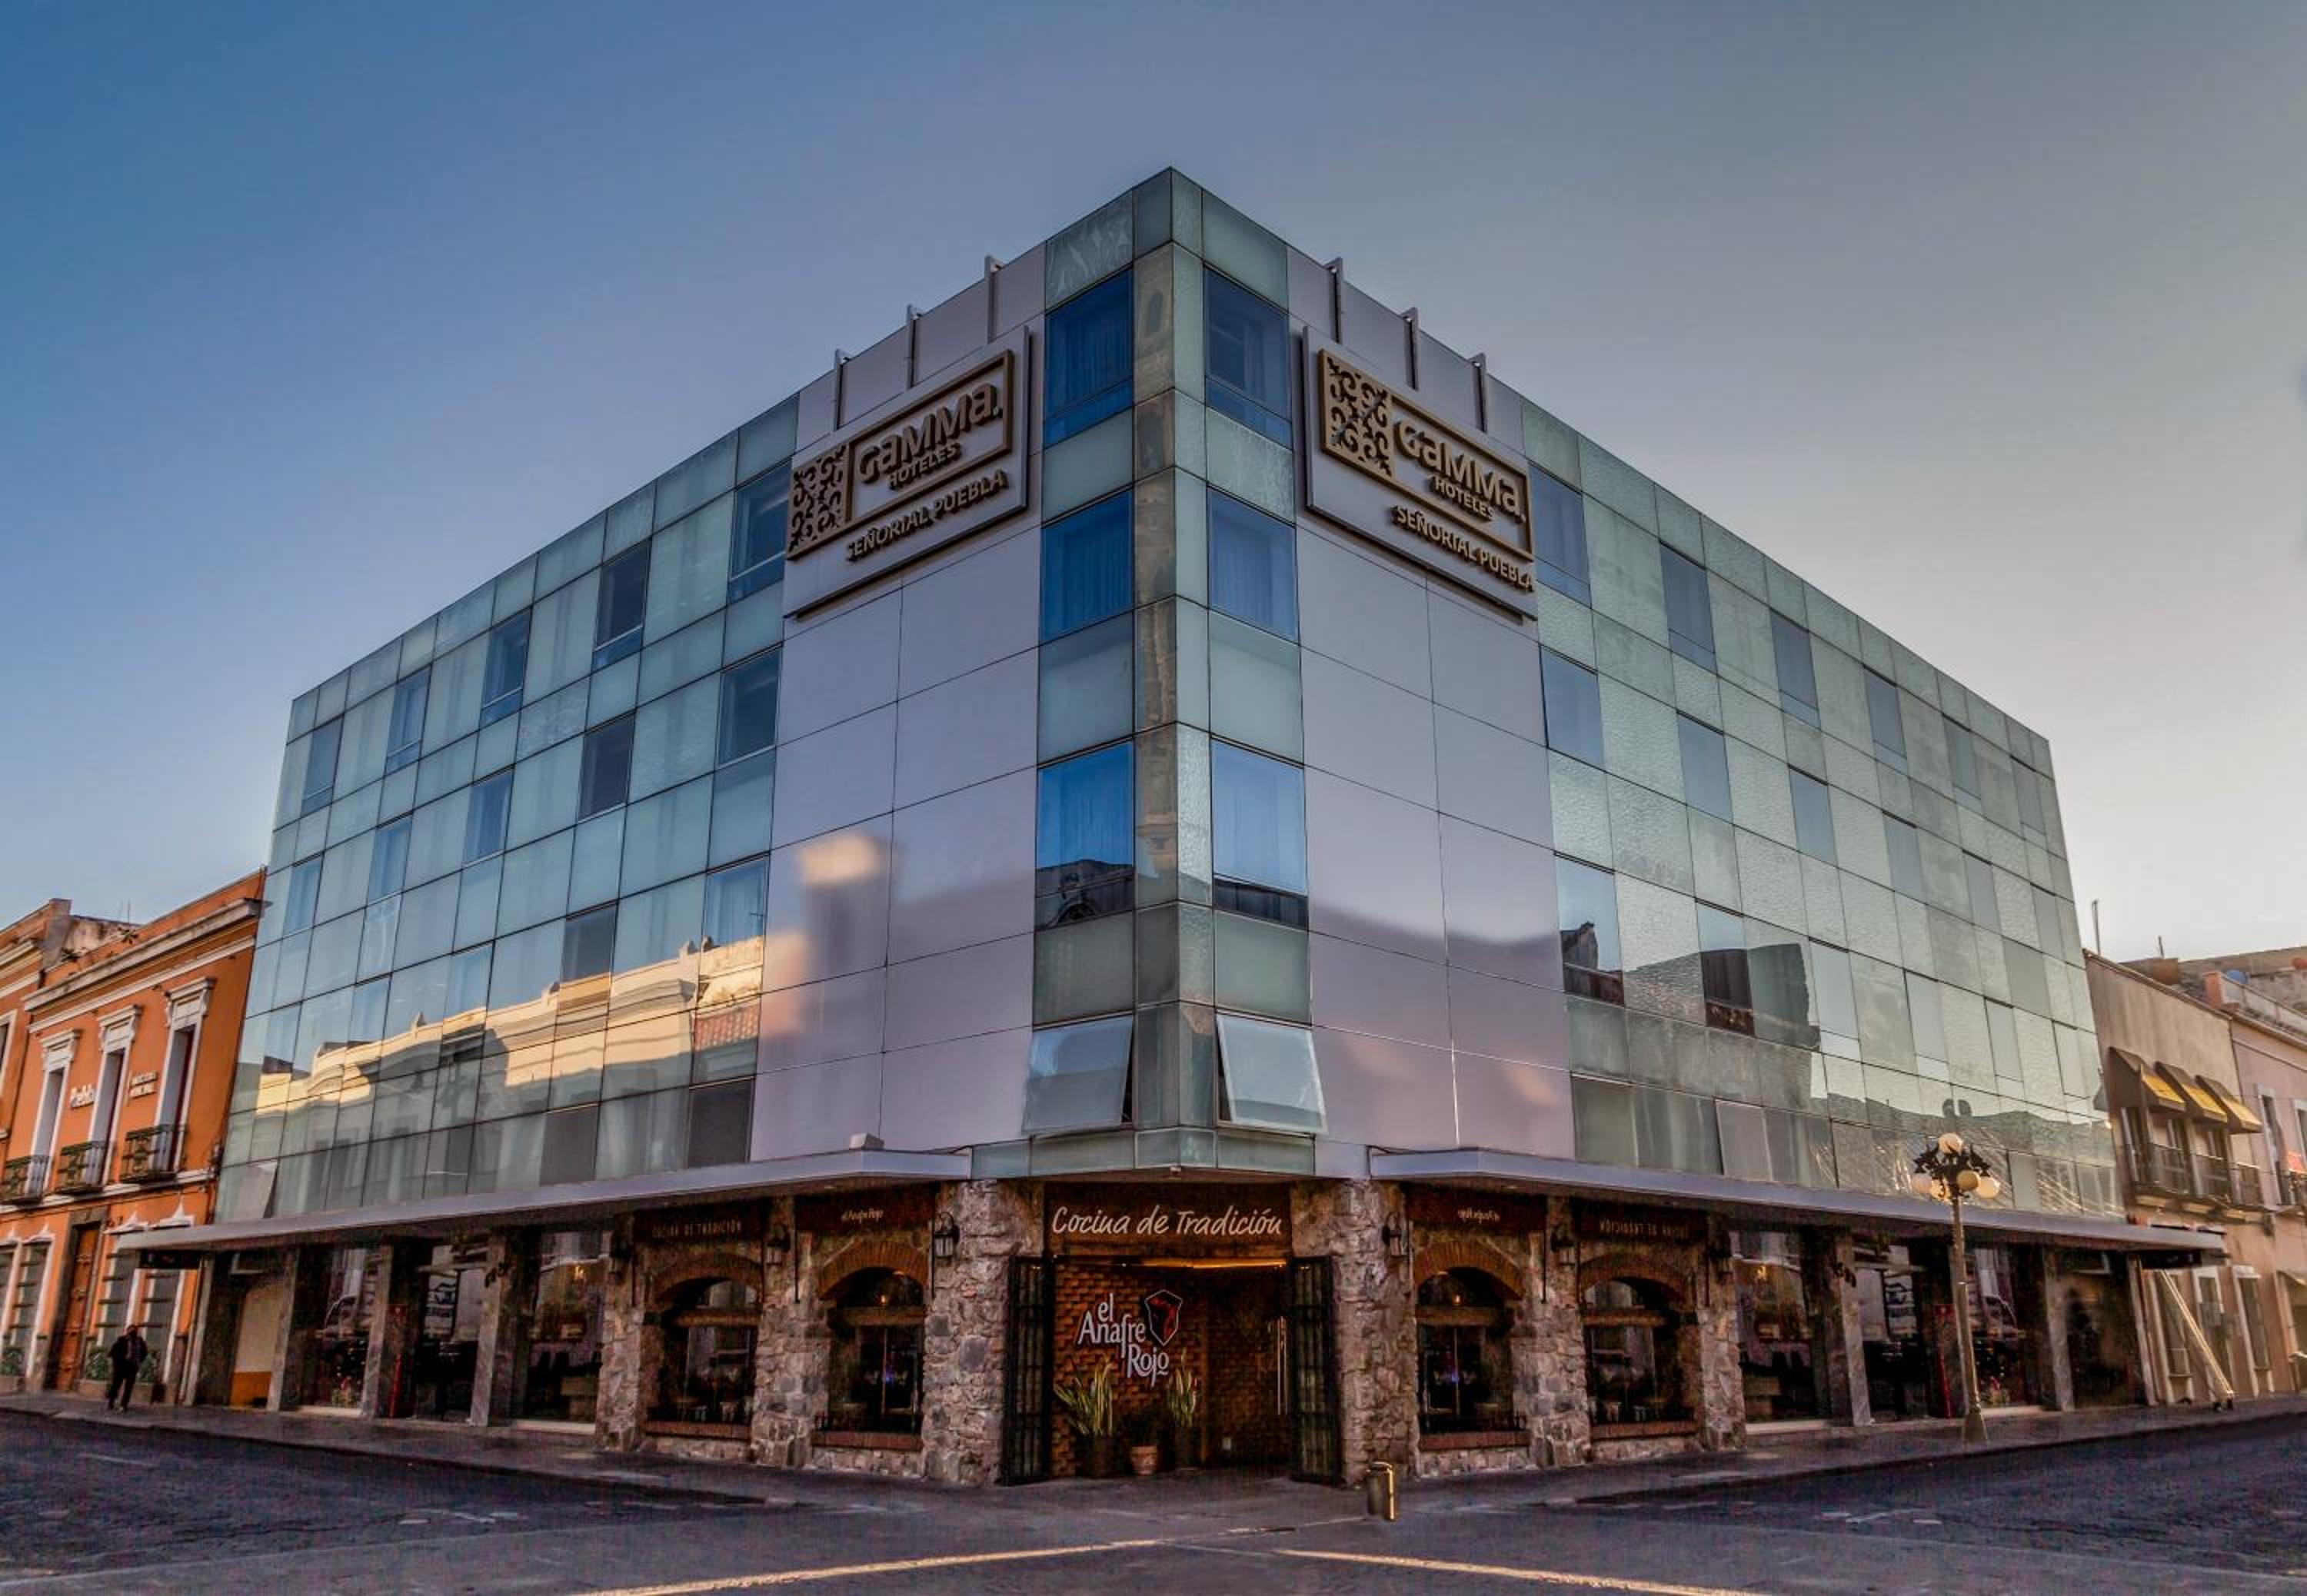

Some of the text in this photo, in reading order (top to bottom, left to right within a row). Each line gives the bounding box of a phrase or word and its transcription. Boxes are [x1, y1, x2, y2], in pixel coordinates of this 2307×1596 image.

[888, 441, 961, 490] HOTELES
[934, 468, 1008, 520] PUEBLA
[1429, 475, 1494, 521] HOTELES
[1391, 505, 1533, 591] SEÑORIAL PUEBLA
[1052, 1205, 1282, 1235] Cocina de Tradición
[1097, 1292, 1114, 1322] el
[1077, 1310, 1146, 1358] Anafre
[1127, 1343, 1170, 1387] Rojo
